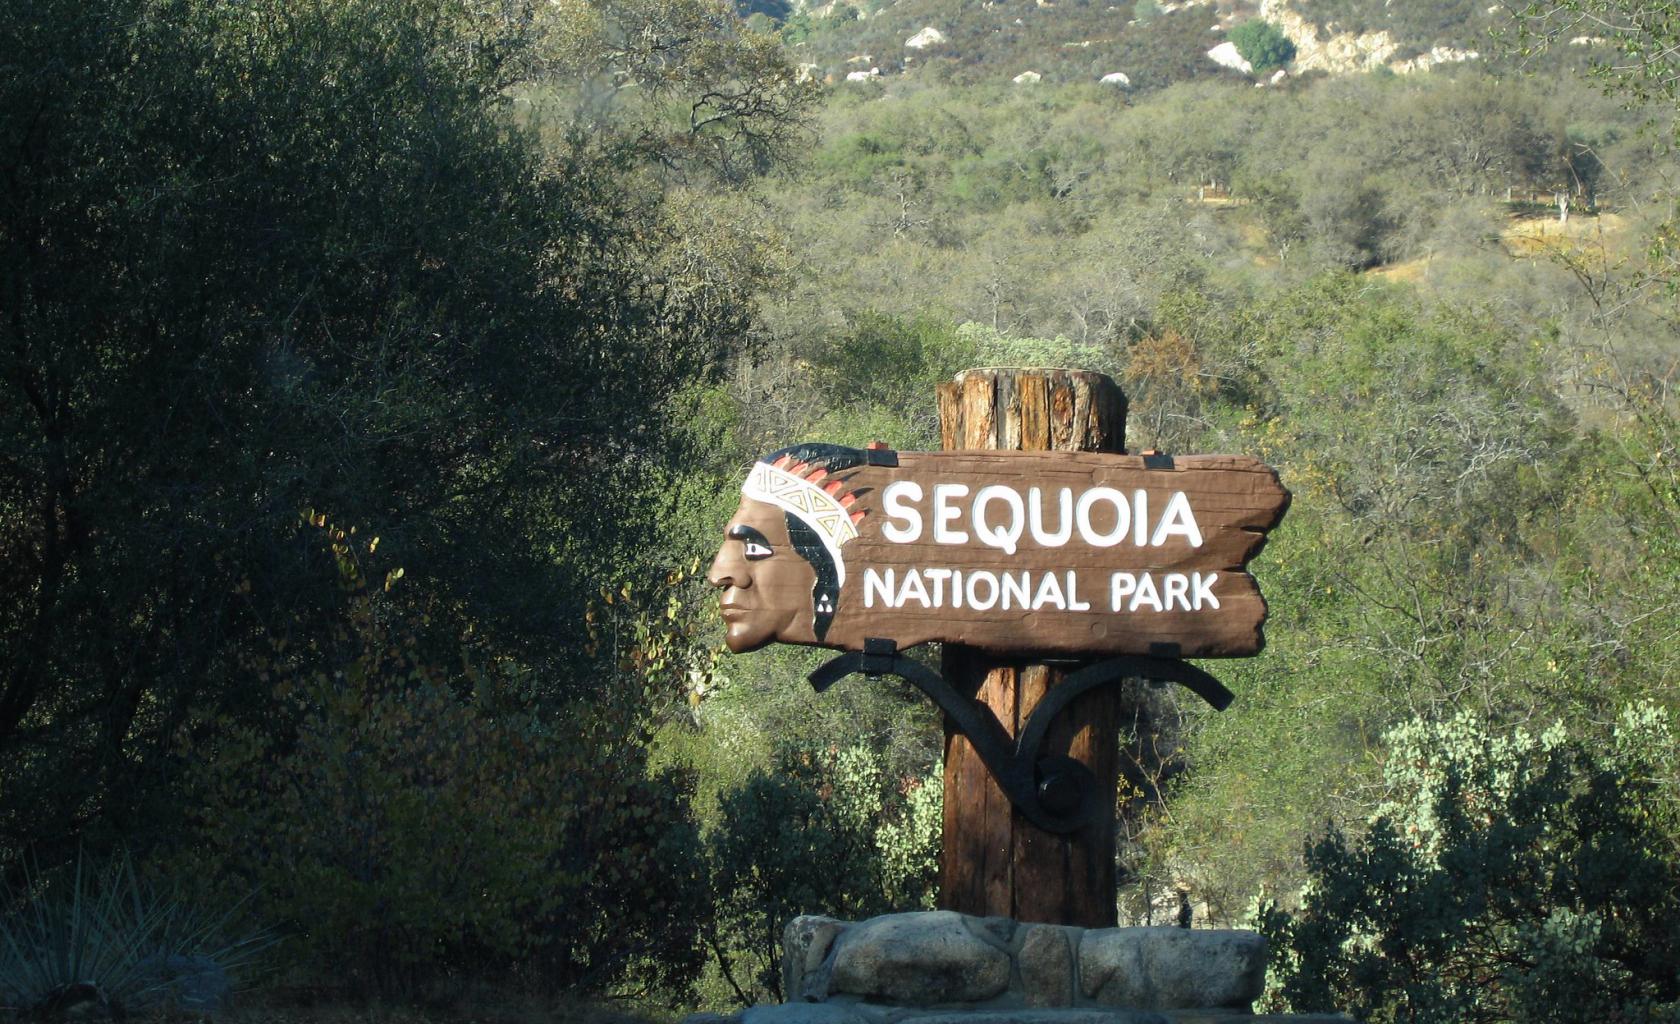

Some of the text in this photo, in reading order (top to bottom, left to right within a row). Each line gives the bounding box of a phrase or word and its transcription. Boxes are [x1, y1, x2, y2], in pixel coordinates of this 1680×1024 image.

[881, 480, 1204, 556] SEQUOIA
[863, 567, 1220, 613] NATIONAL PARK
